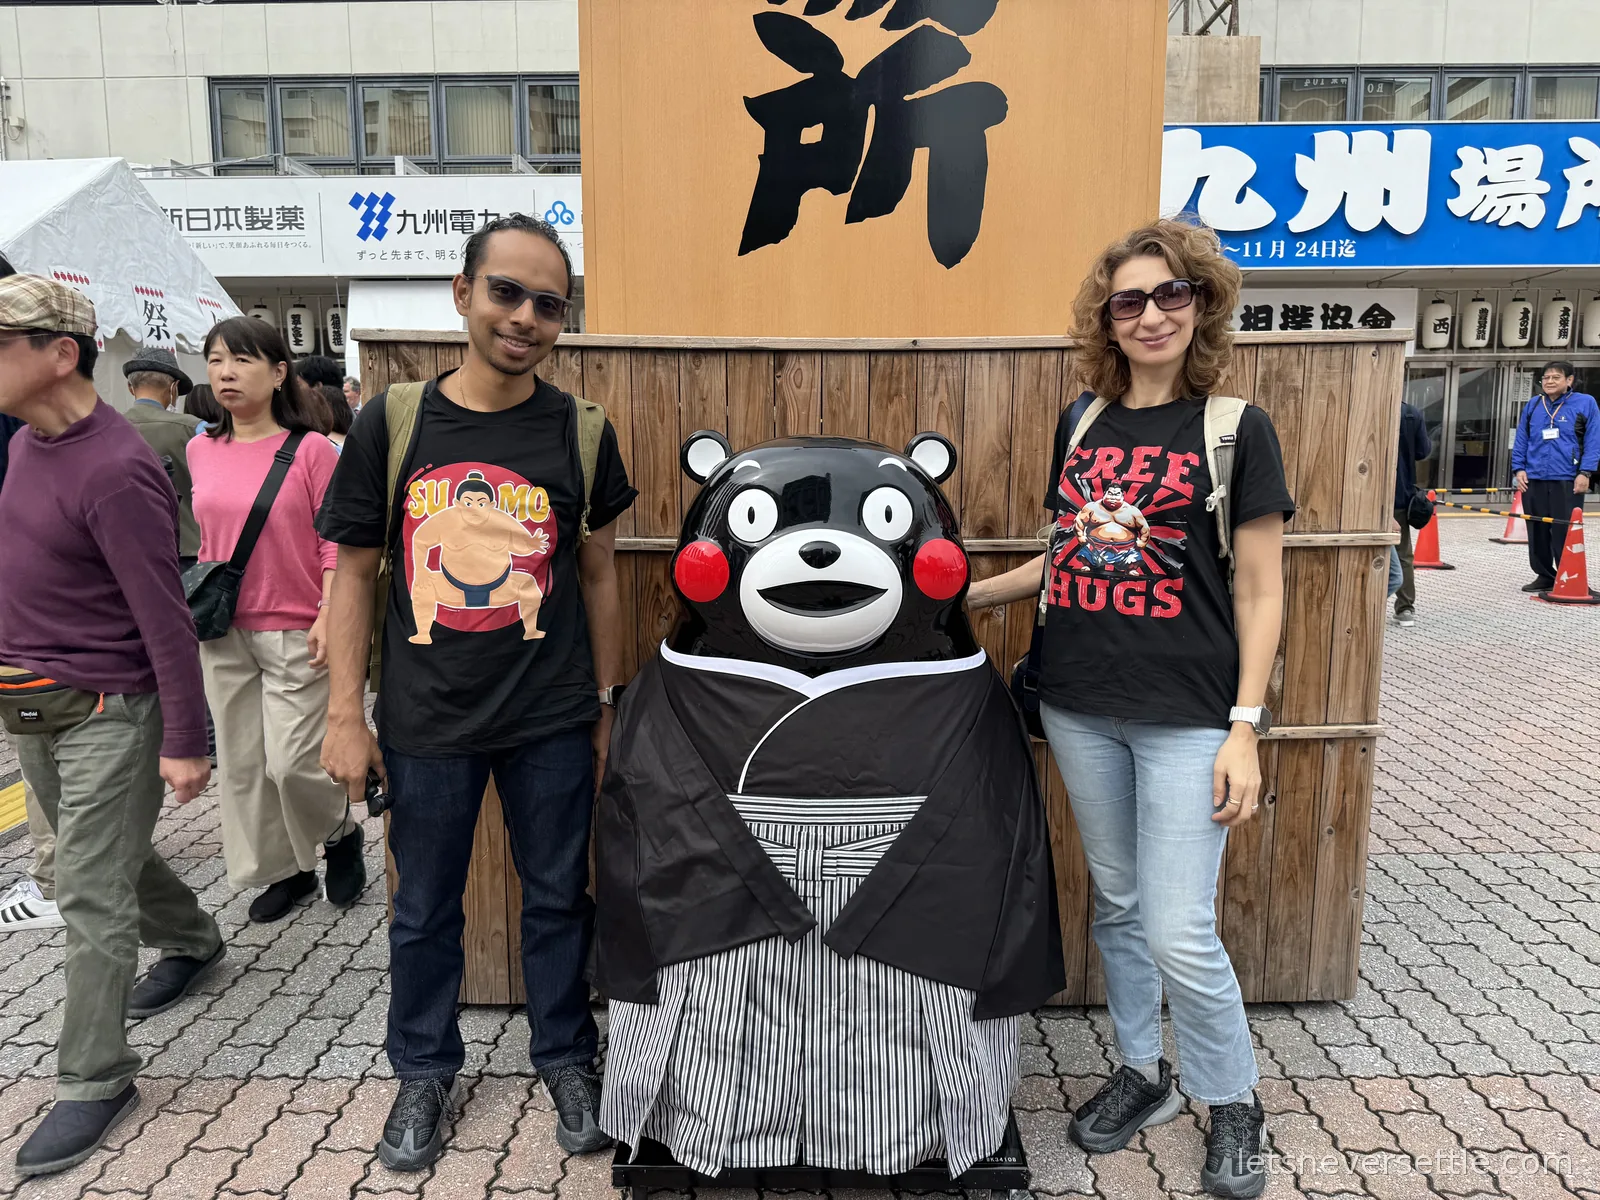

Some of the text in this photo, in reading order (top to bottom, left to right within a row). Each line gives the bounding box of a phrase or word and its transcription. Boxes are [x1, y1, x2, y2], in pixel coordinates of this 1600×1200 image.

[738, 0, 1008, 270] 所
[143, 299, 171, 341] 祭
[1433, 317, 1450, 335] 西
[1518, 307, 1531, 340] 大の里
[1059, 446, 1200, 500] FREE
[1047, 566, 1184, 619] HUGS
